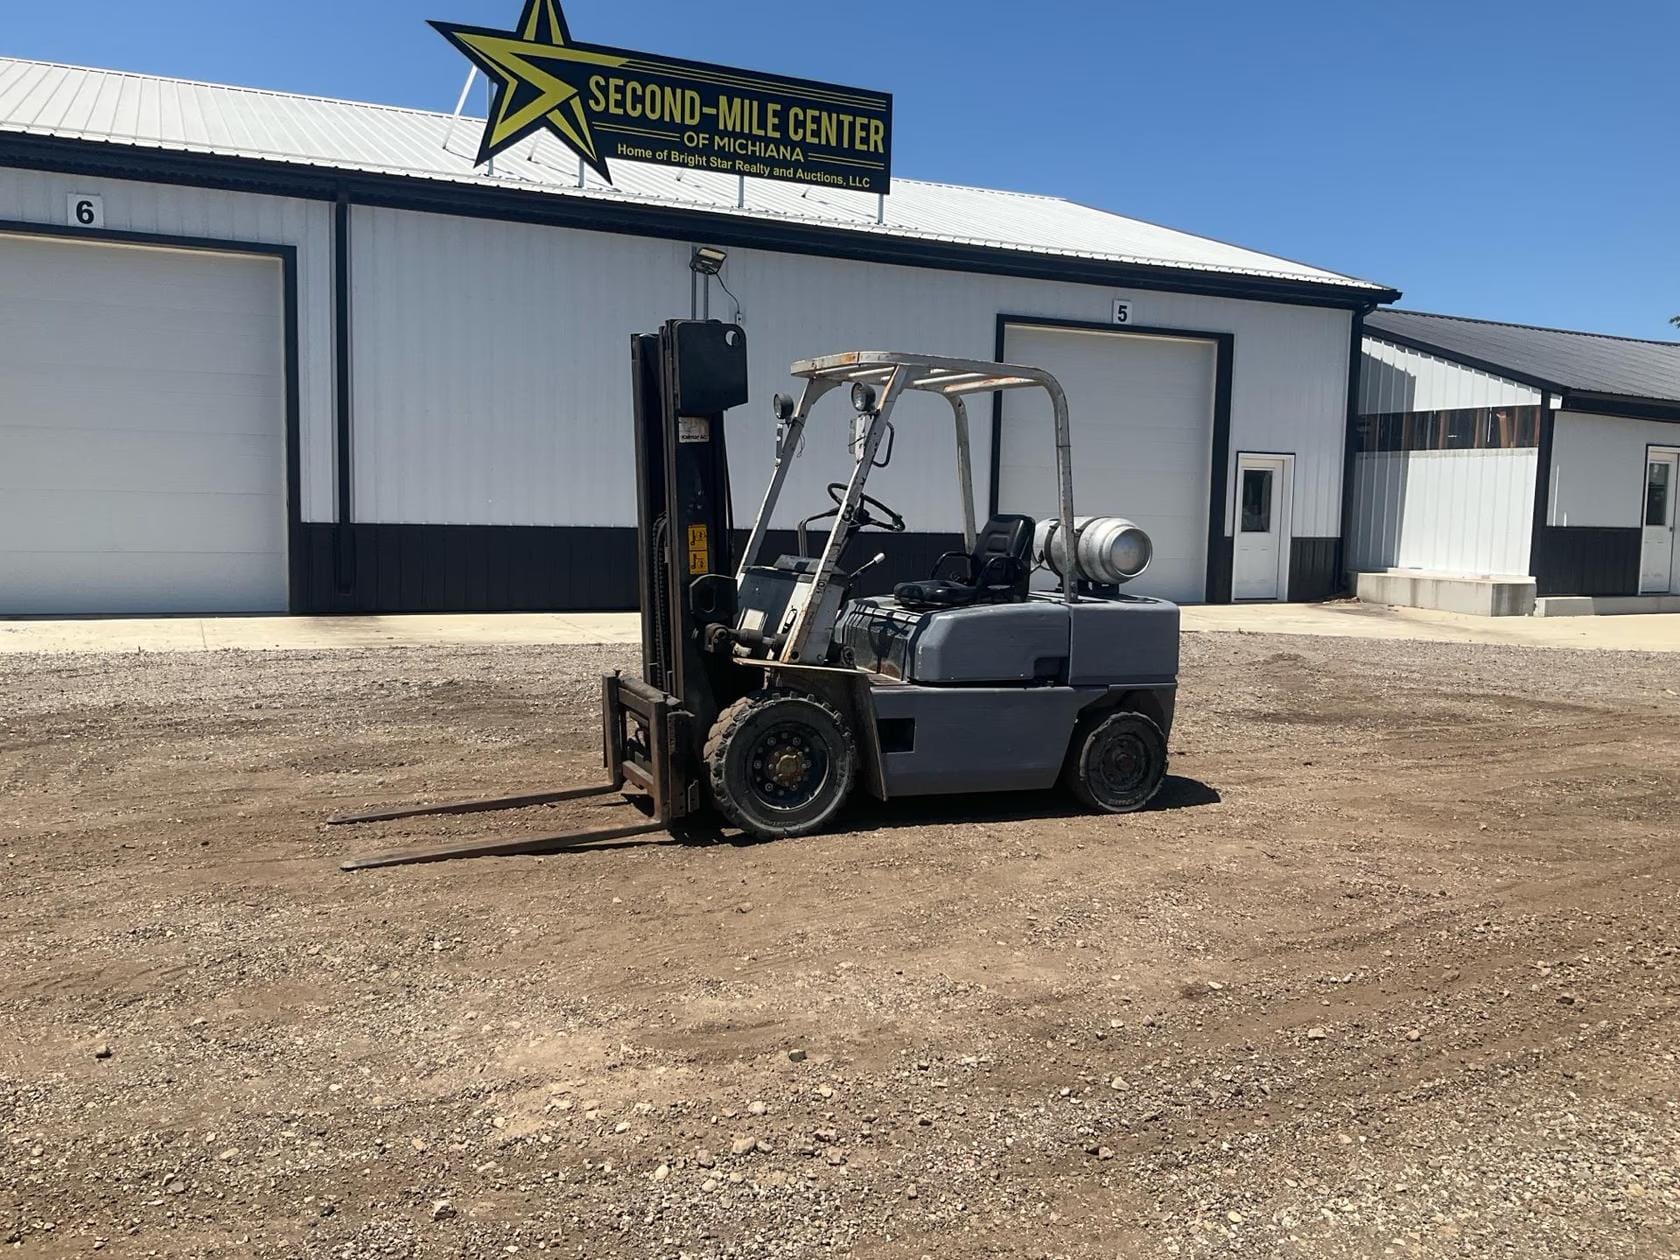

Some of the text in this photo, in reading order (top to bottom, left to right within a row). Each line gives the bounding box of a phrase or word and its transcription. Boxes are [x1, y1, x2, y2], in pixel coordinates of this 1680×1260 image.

[588, 74, 885, 154] SECOND-MILE CENTER
[683, 131, 805, 162] OF MICHIANA
[617, 143, 870, 188] Home of Bright Star Realty and Auctions, LLC
[75, 200, 95, 225] 6
[1117, 304, 1128, 323] 5
